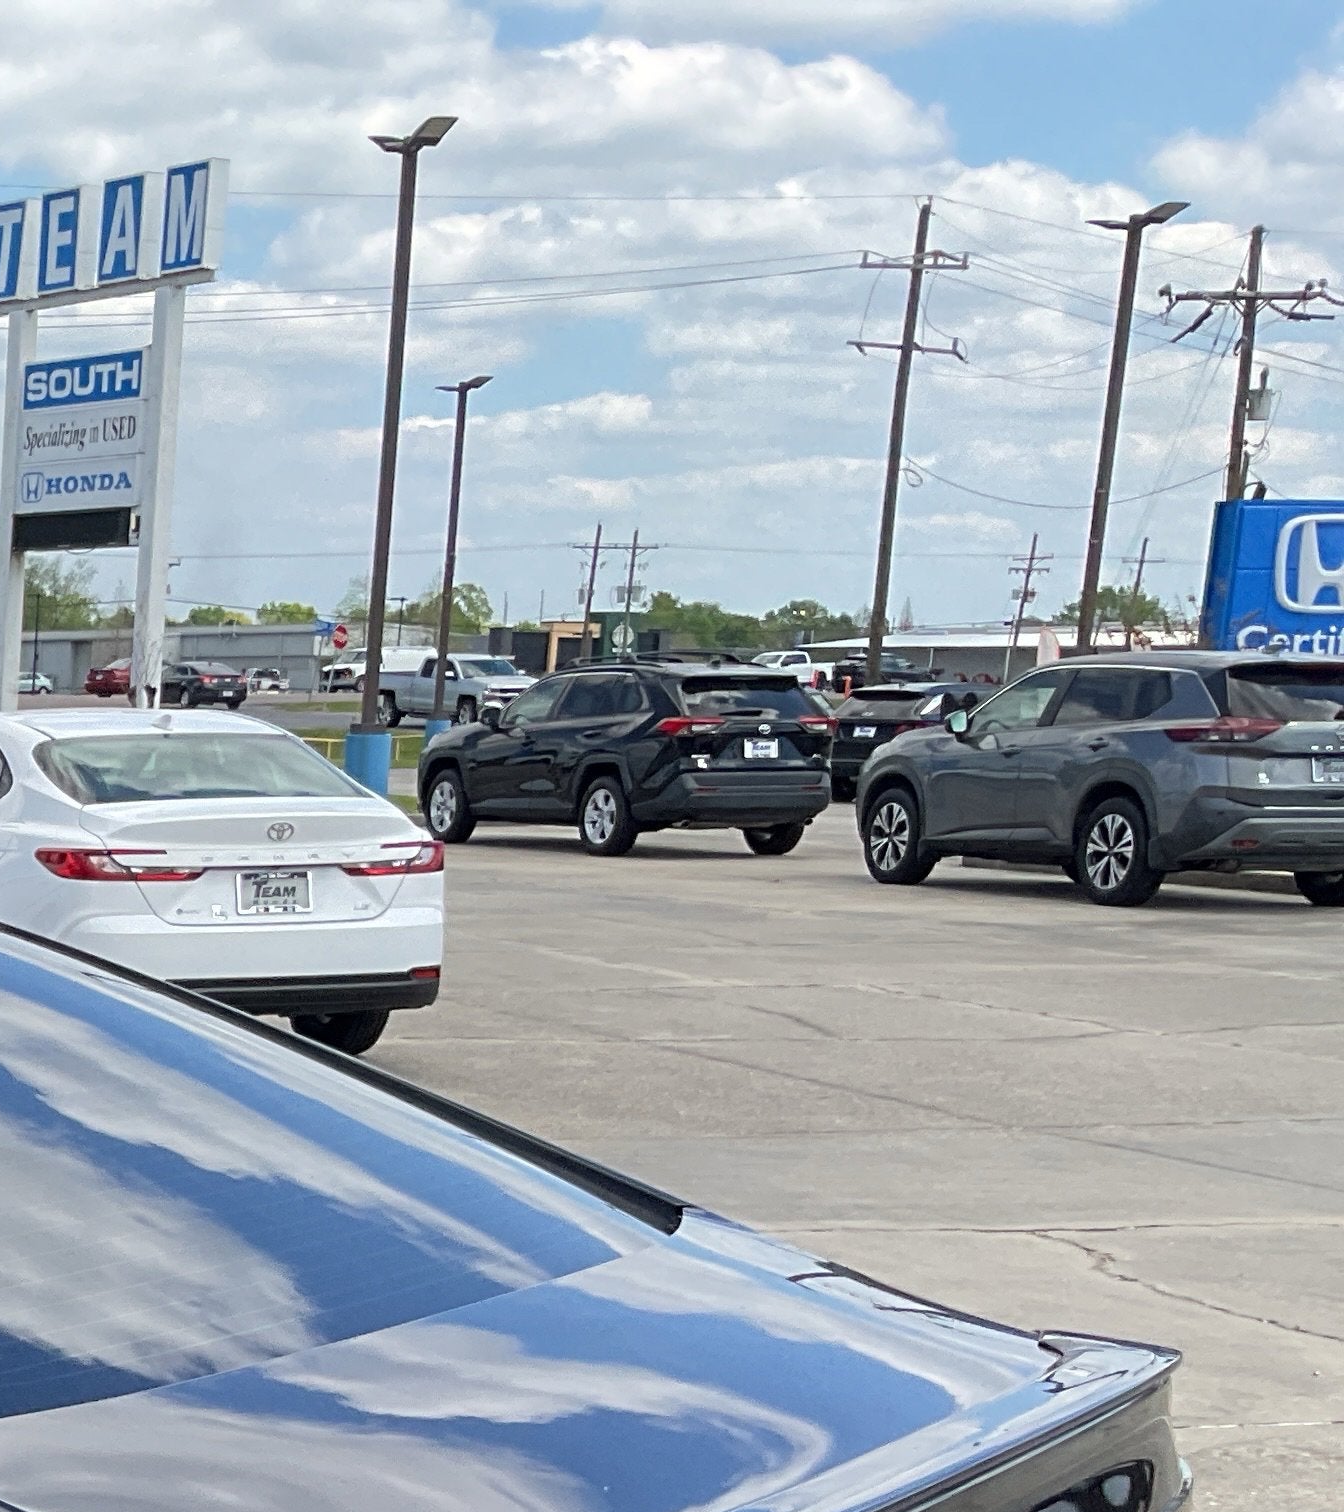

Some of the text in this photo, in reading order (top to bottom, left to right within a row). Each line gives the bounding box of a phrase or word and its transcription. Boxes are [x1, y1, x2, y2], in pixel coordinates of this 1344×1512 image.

[26, 359, 140, 402] SOUTH
[24, 415, 136, 457] Specializing in USED
[45, 471, 132, 495] HONDA
[252, 879, 297, 898] TEAM
